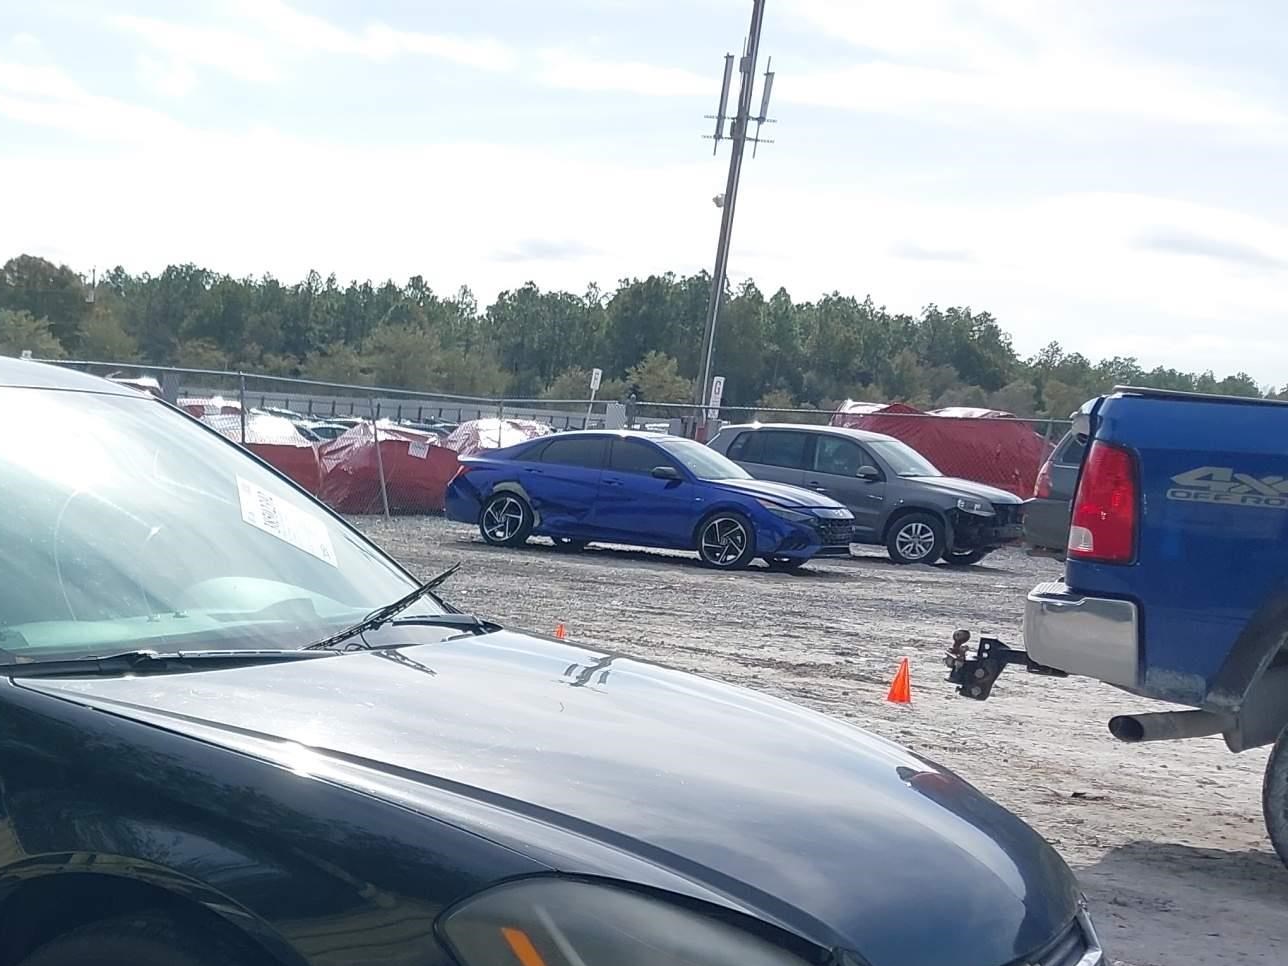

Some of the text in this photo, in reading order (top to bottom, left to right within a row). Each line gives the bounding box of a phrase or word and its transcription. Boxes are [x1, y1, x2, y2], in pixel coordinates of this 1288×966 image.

[714, 380, 722, 396] G
[1170, 466, 1288, 497] 4X
[1169, 490, 1288, 508] OFF RO
